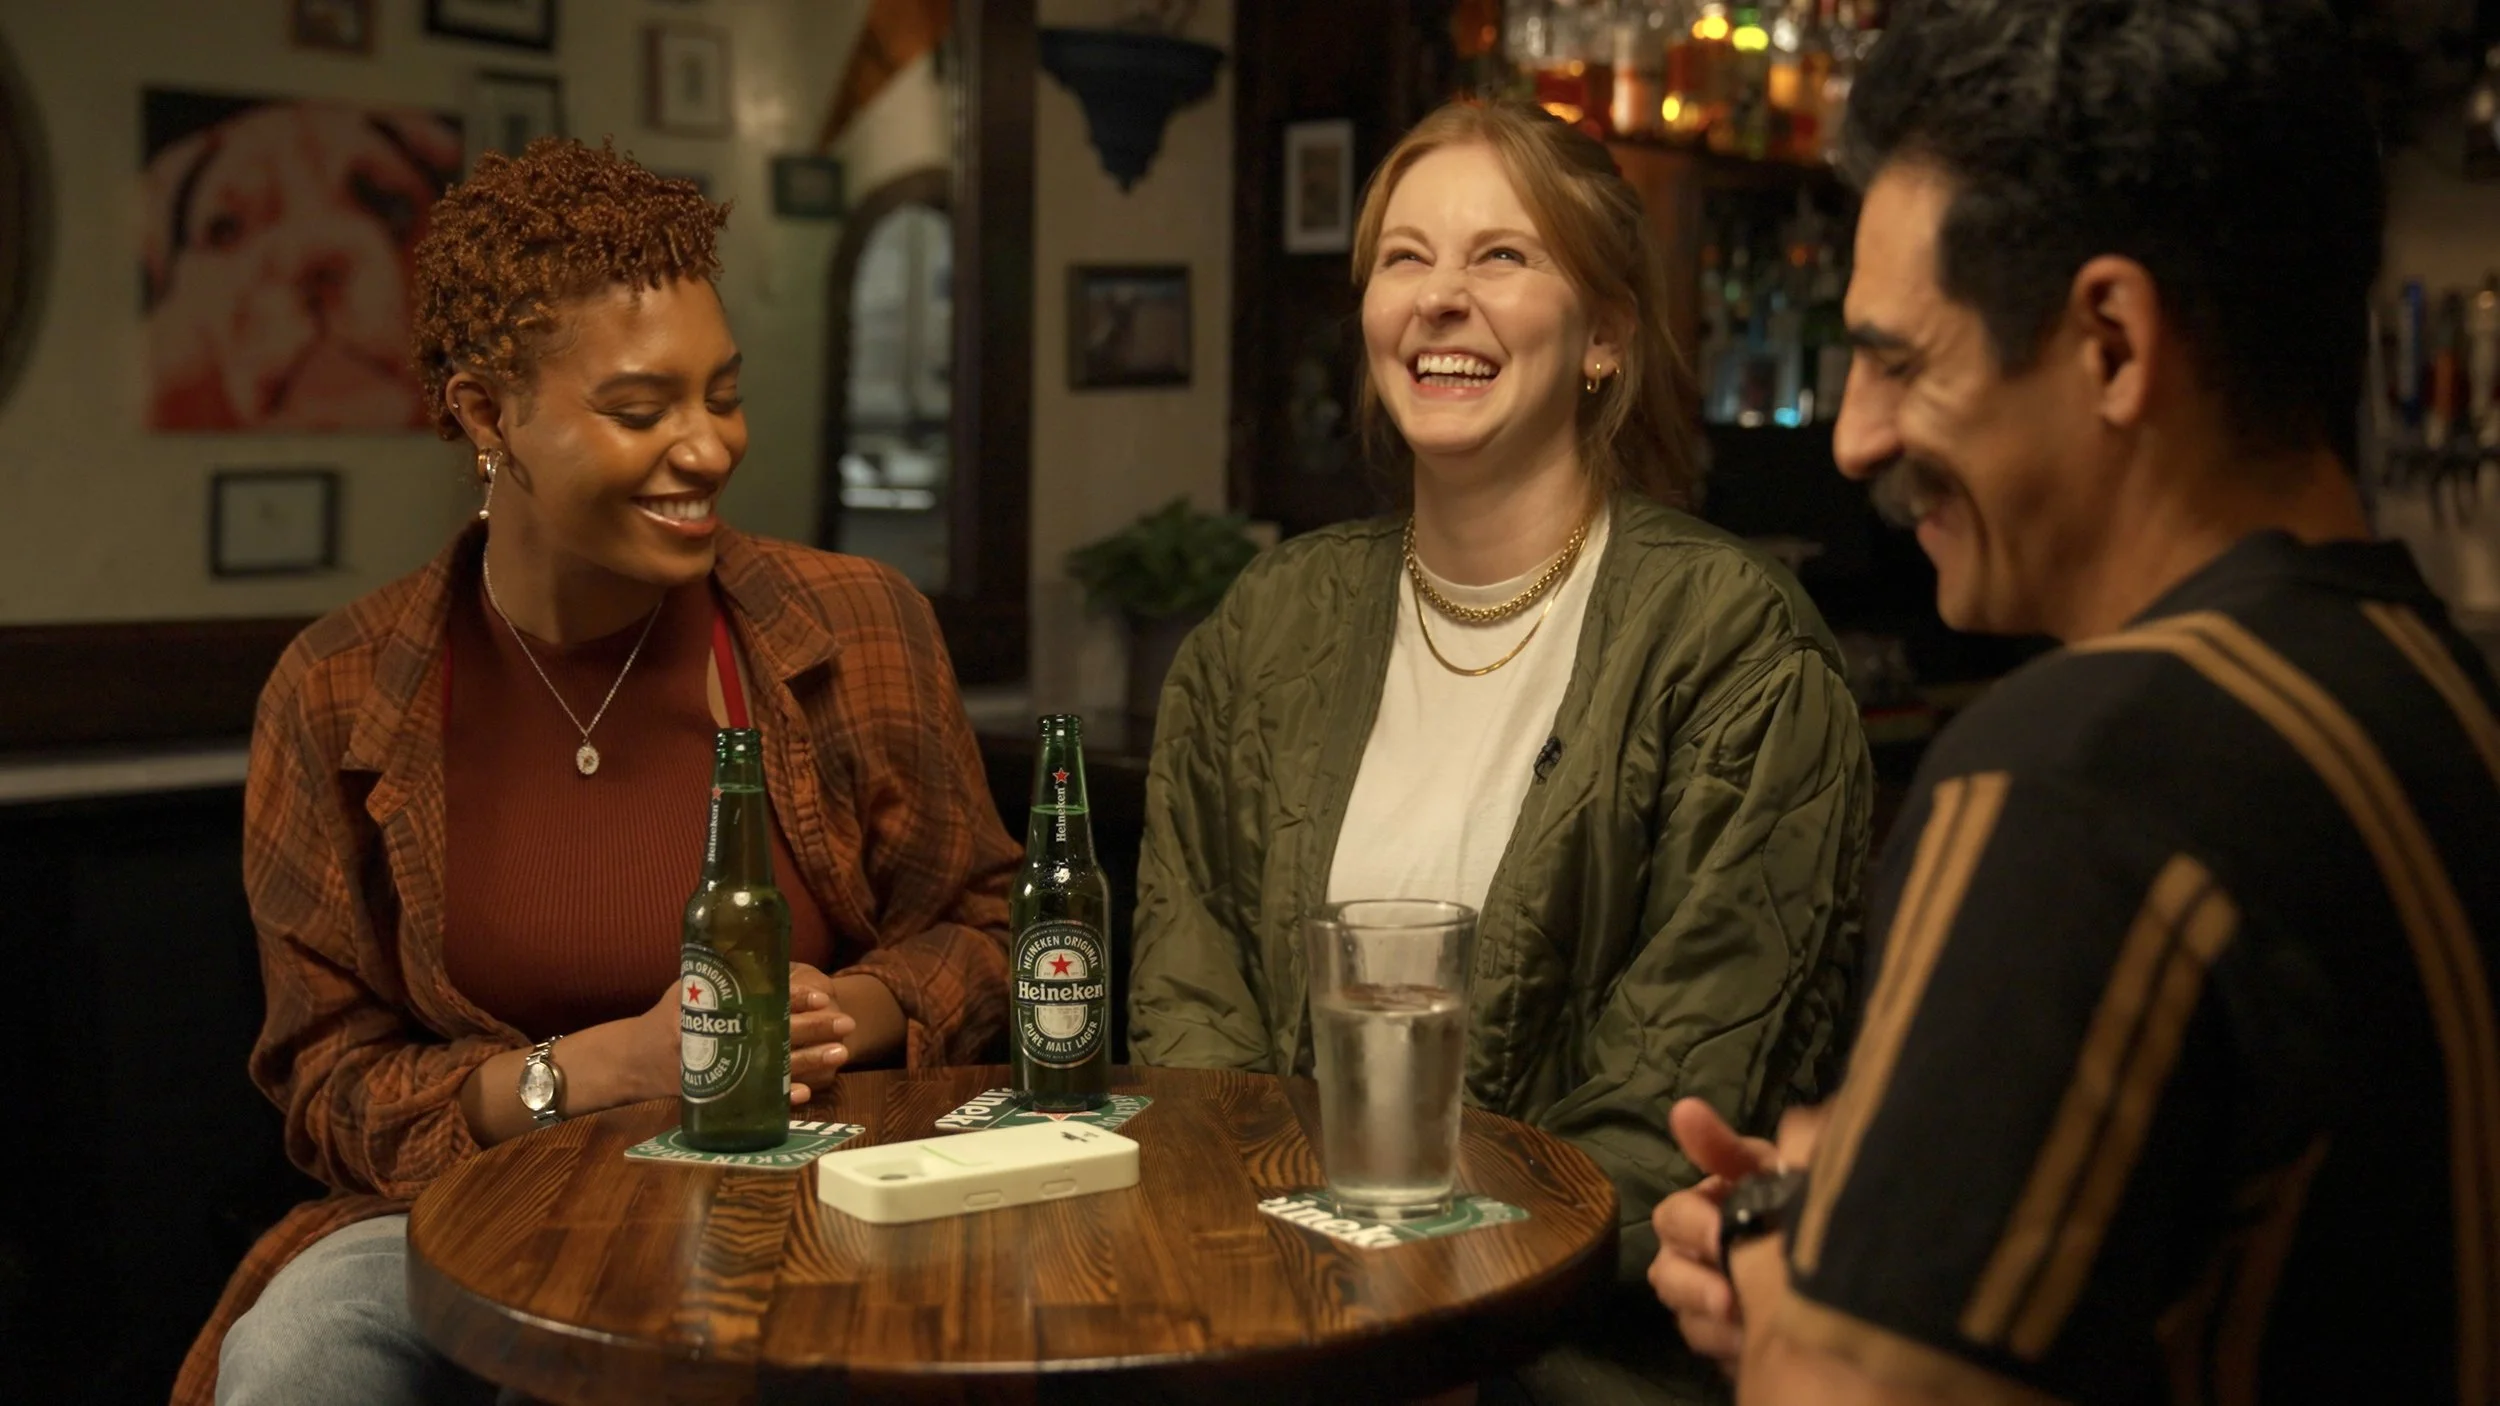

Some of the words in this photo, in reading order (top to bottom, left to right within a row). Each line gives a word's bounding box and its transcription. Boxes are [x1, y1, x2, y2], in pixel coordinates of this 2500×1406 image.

[1056, 787, 1066, 842] Heineken
[1023, 936, 1060, 970] HEINEKEN
[1064, 936, 1099, 968] ORIGINAL
[695, 961, 733, 1001] ORIGINAL
[1018, 981, 1104, 1001] Heineken
[1024, 1022, 1044, 1047] PURE
[1045, 1041, 1072, 1052] MALT
[1075, 1021, 1098, 1048] LAGER
[684, 1071, 702, 1086] MALT
[704, 1057, 731, 1084] LAGER
